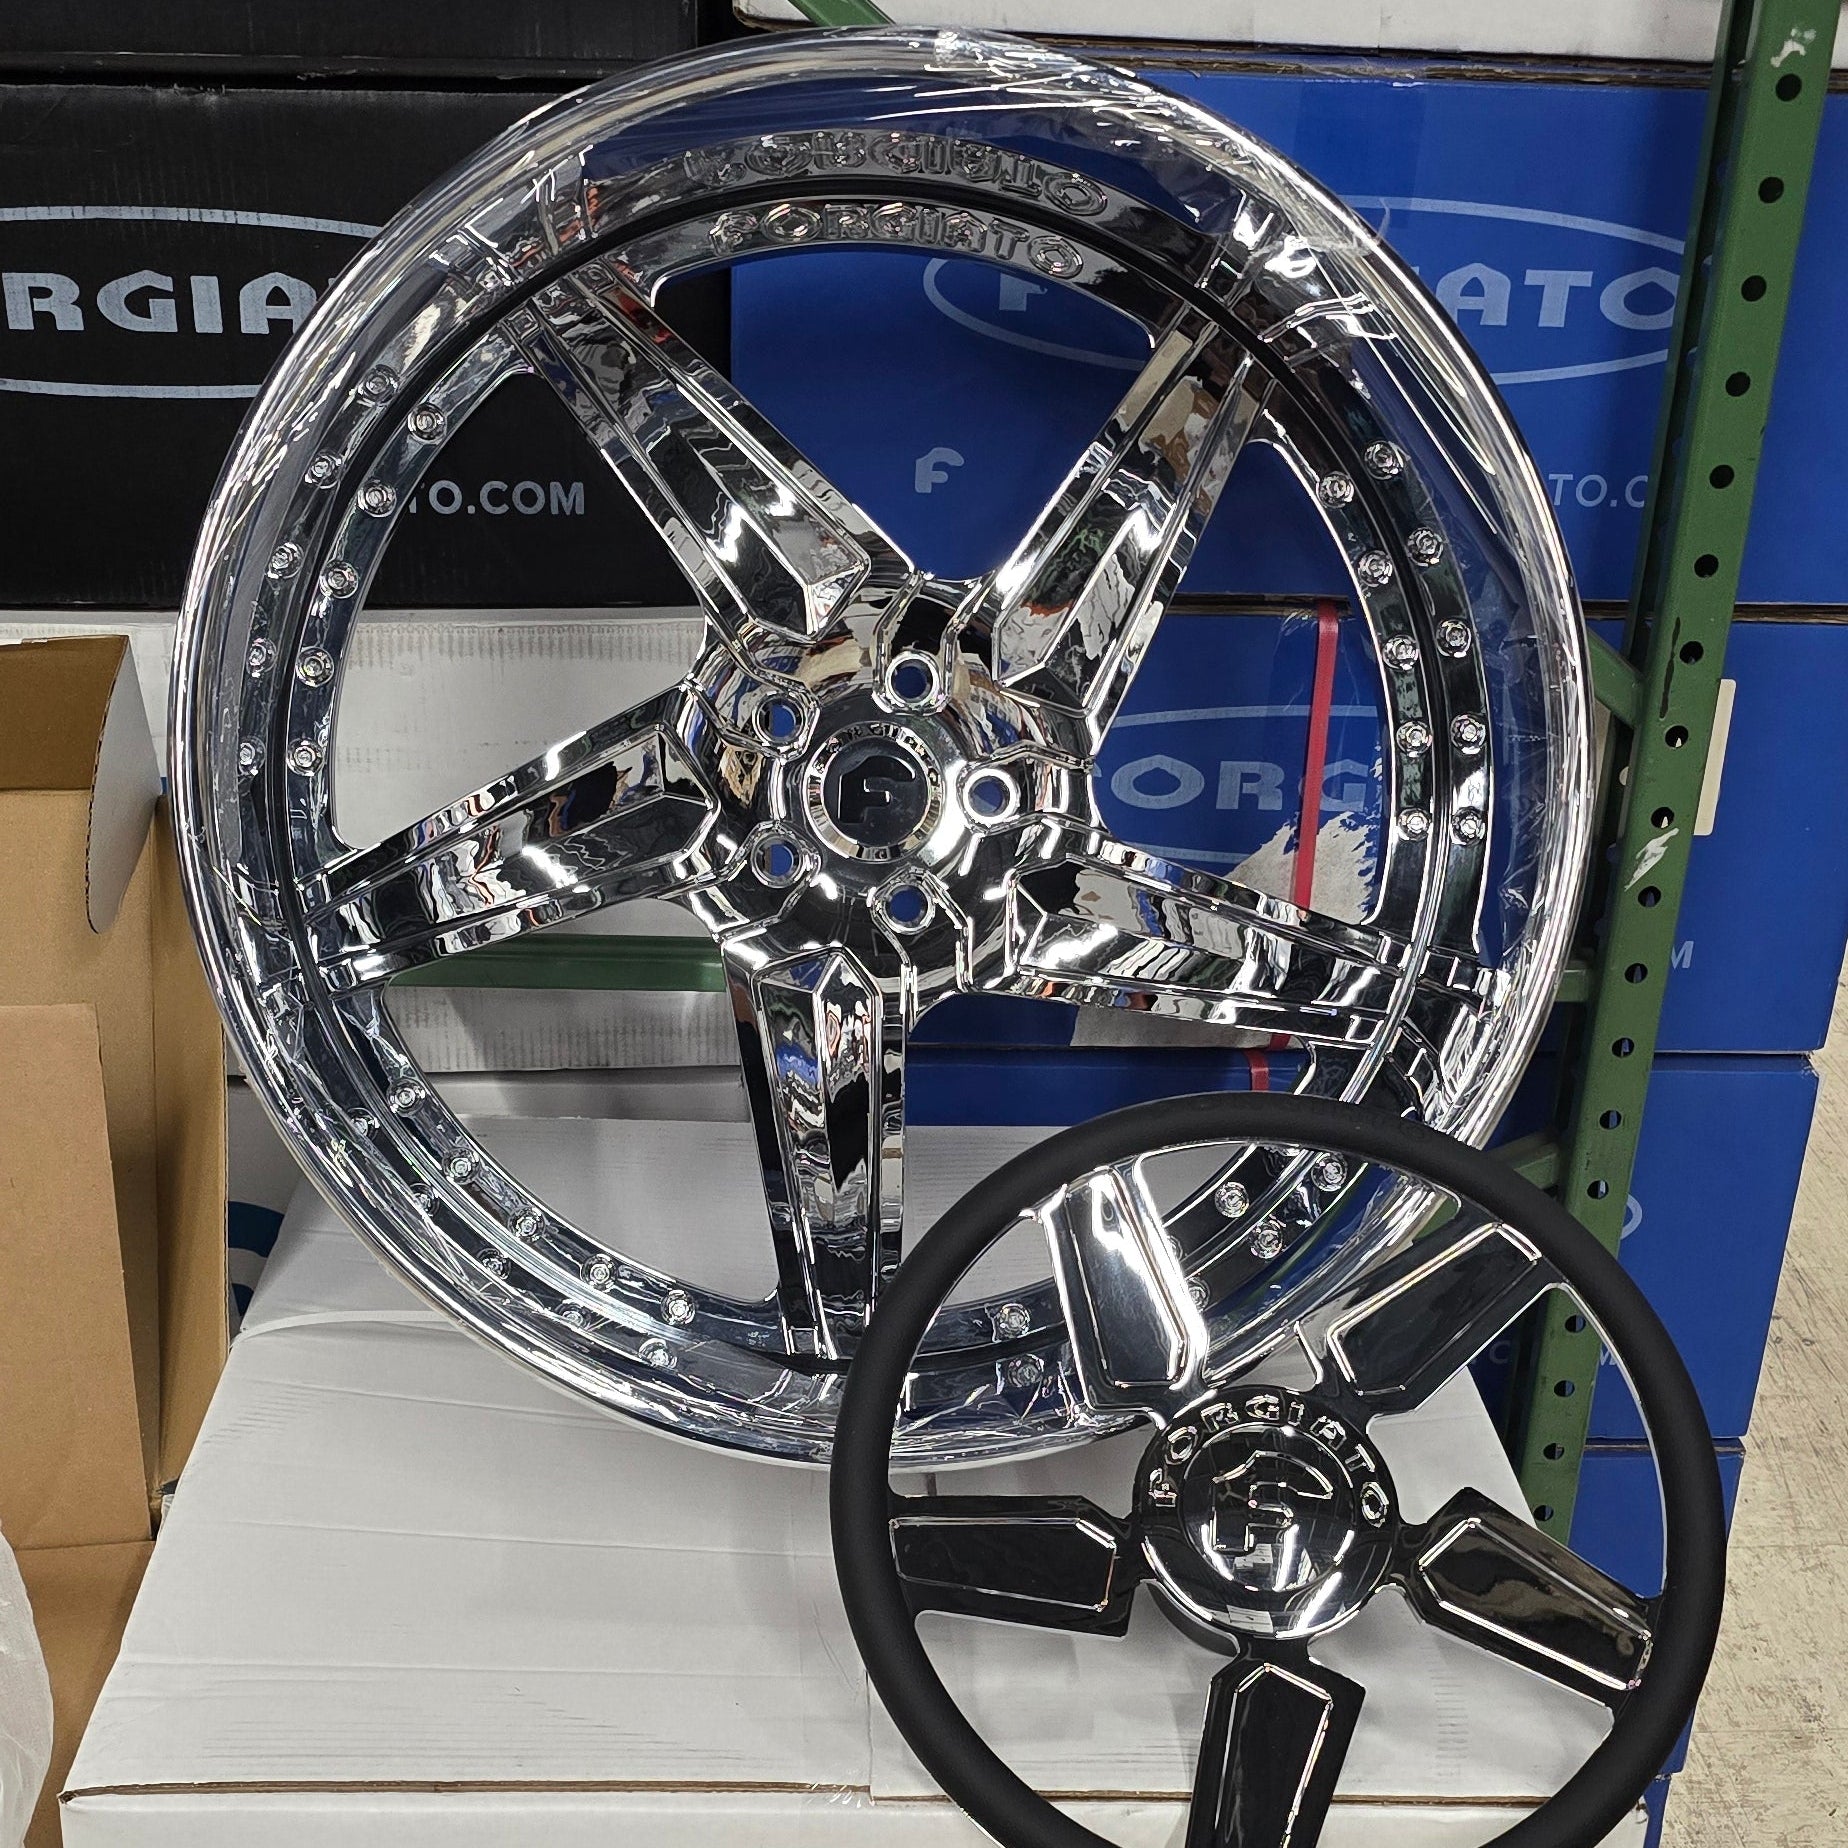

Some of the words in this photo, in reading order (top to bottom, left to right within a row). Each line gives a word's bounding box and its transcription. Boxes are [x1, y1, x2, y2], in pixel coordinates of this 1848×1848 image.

[708, 202, 1085, 279] FORGIATO
[1094, 754, 1370, 812] ORG
[1148, 1394, 1389, 1528] FORGIATO
